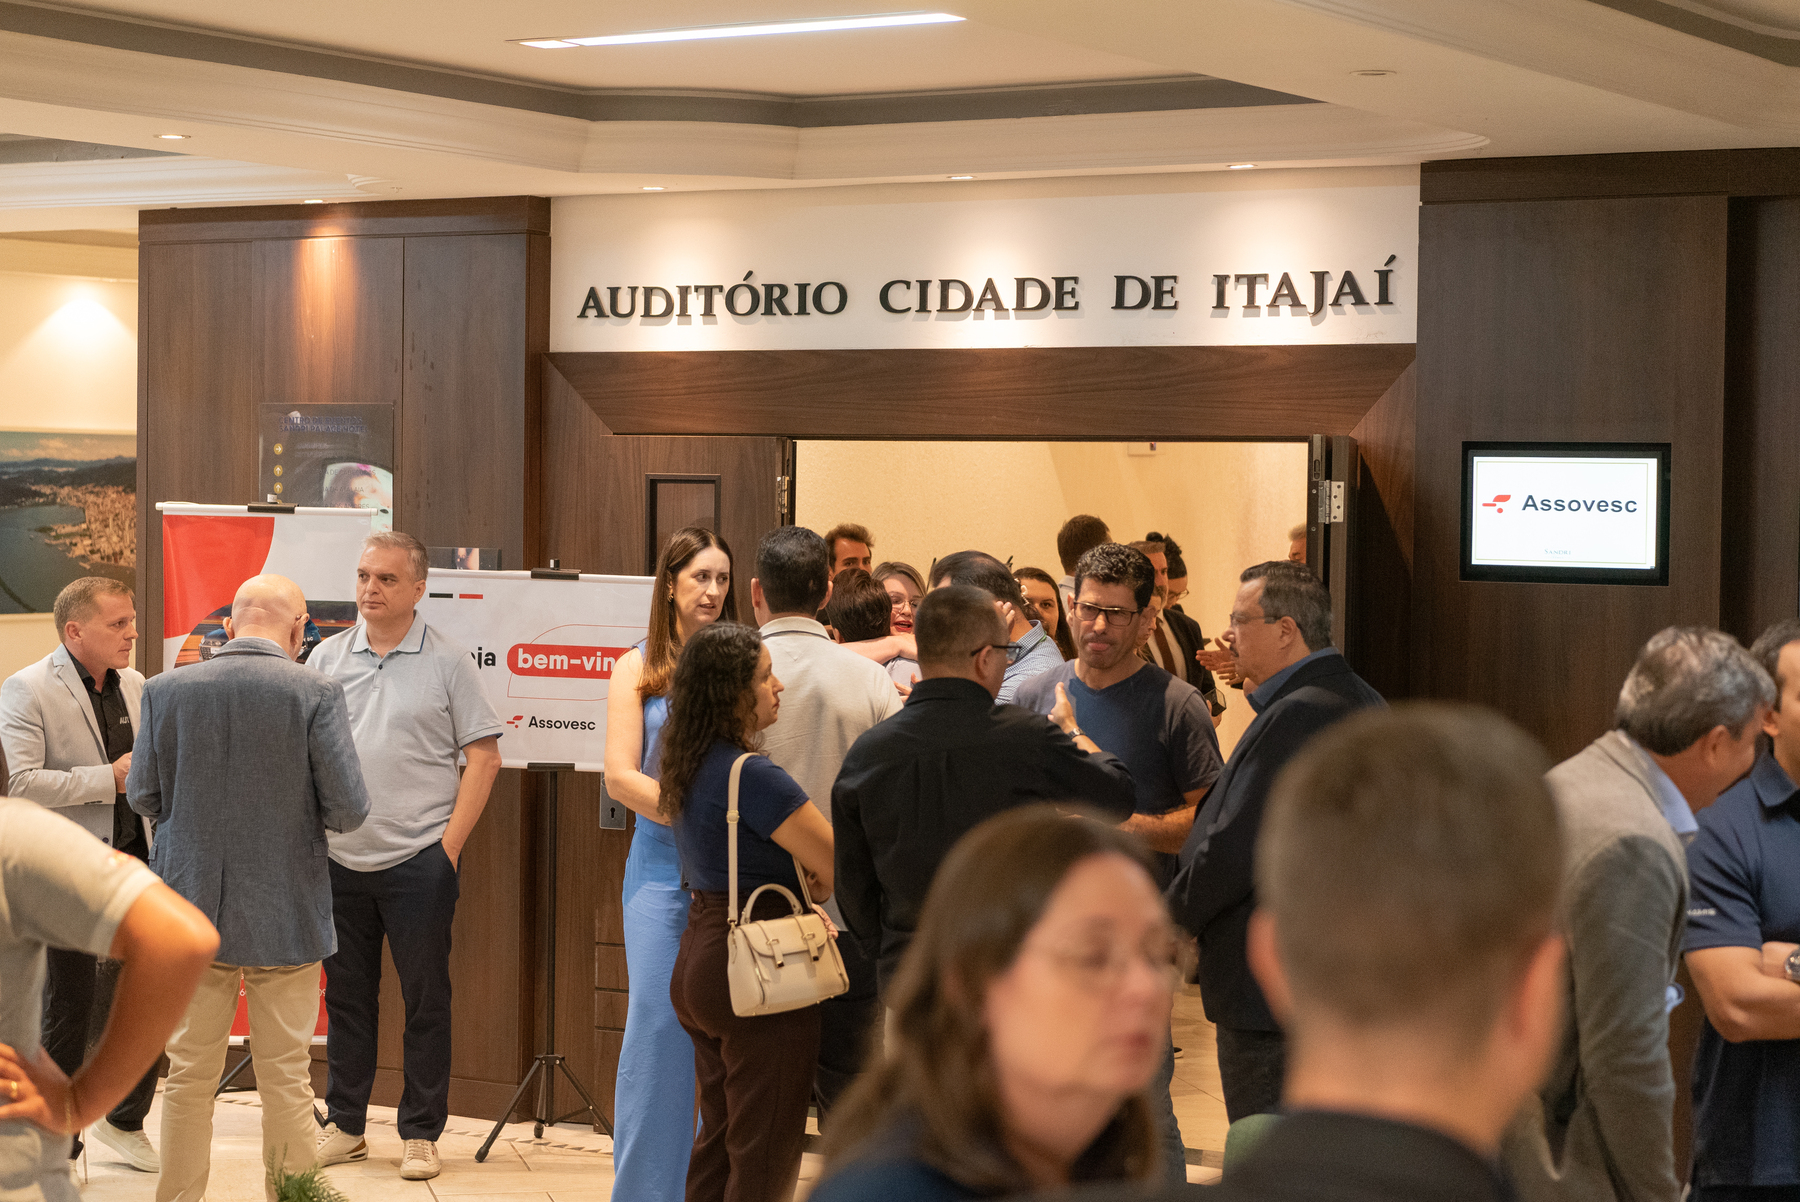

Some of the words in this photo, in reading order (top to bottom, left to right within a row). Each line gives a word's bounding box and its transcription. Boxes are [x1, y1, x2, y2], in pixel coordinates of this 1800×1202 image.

[577, 270, 849, 319] AUDITÓRIO
[879, 276, 1080, 314] CIDADE
[1111, 274, 1180, 311] DE
[1211, 254, 1397, 317] ITAJAÍ
[279, 416, 311, 424] CENTRO
[325, 416, 363, 424] EVENTOS
[1521, 494, 1638, 513] Assovesc
[528, 716, 596, 730] Assovesc
